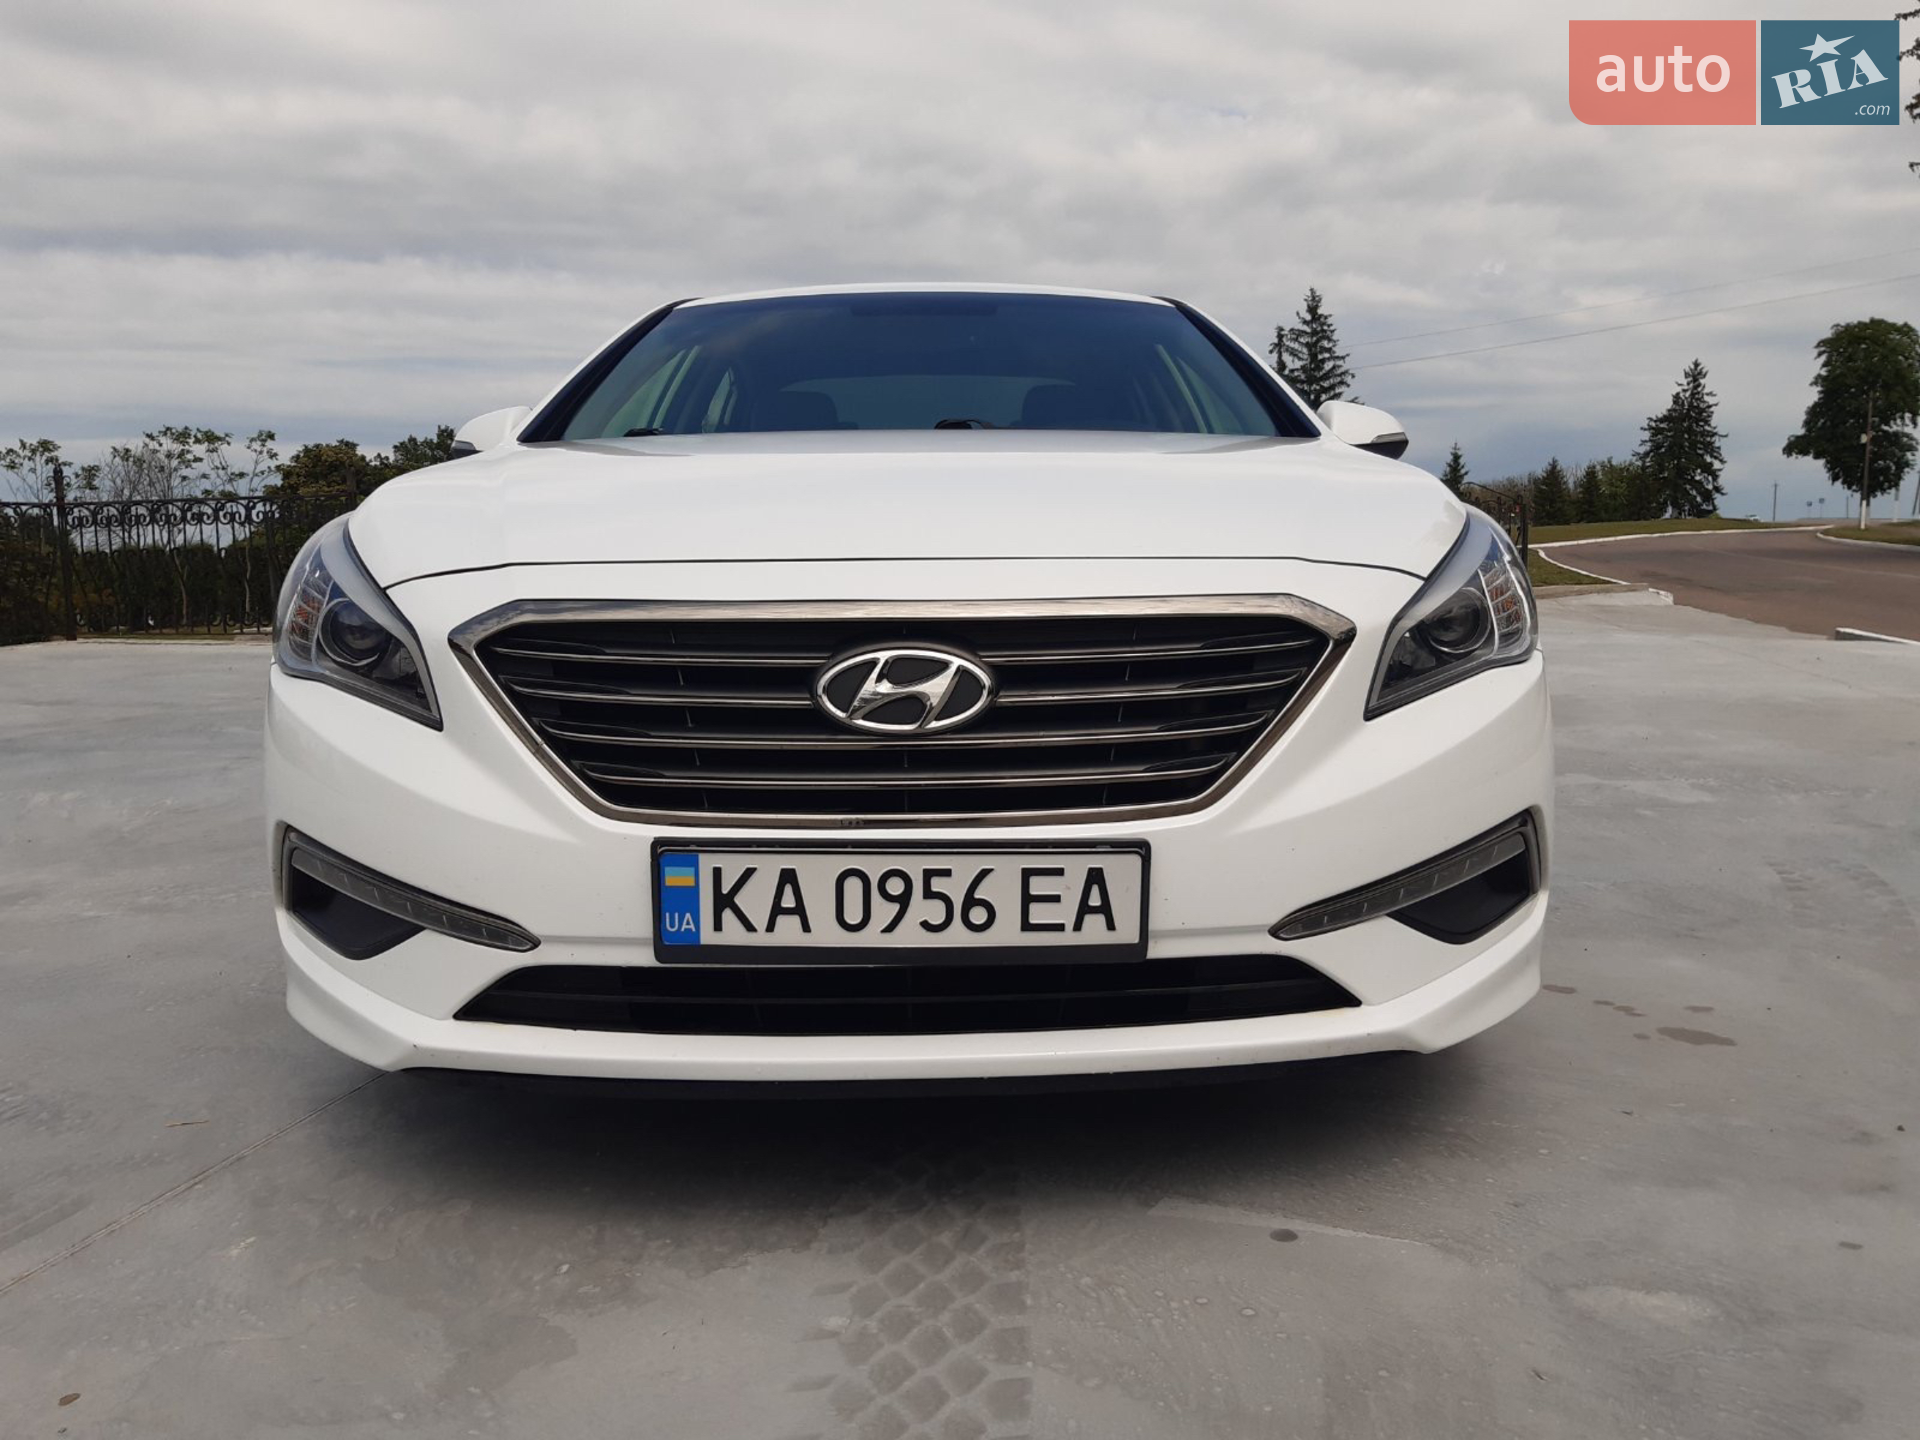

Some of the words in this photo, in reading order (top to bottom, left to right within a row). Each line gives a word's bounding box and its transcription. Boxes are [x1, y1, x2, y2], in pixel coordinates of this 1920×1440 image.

[712, 866, 812, 933] KA
[834, 867, 997, 933] 0956
[1019, 866, 1117, 932] EA
[665, 913, 696, 932] UA
